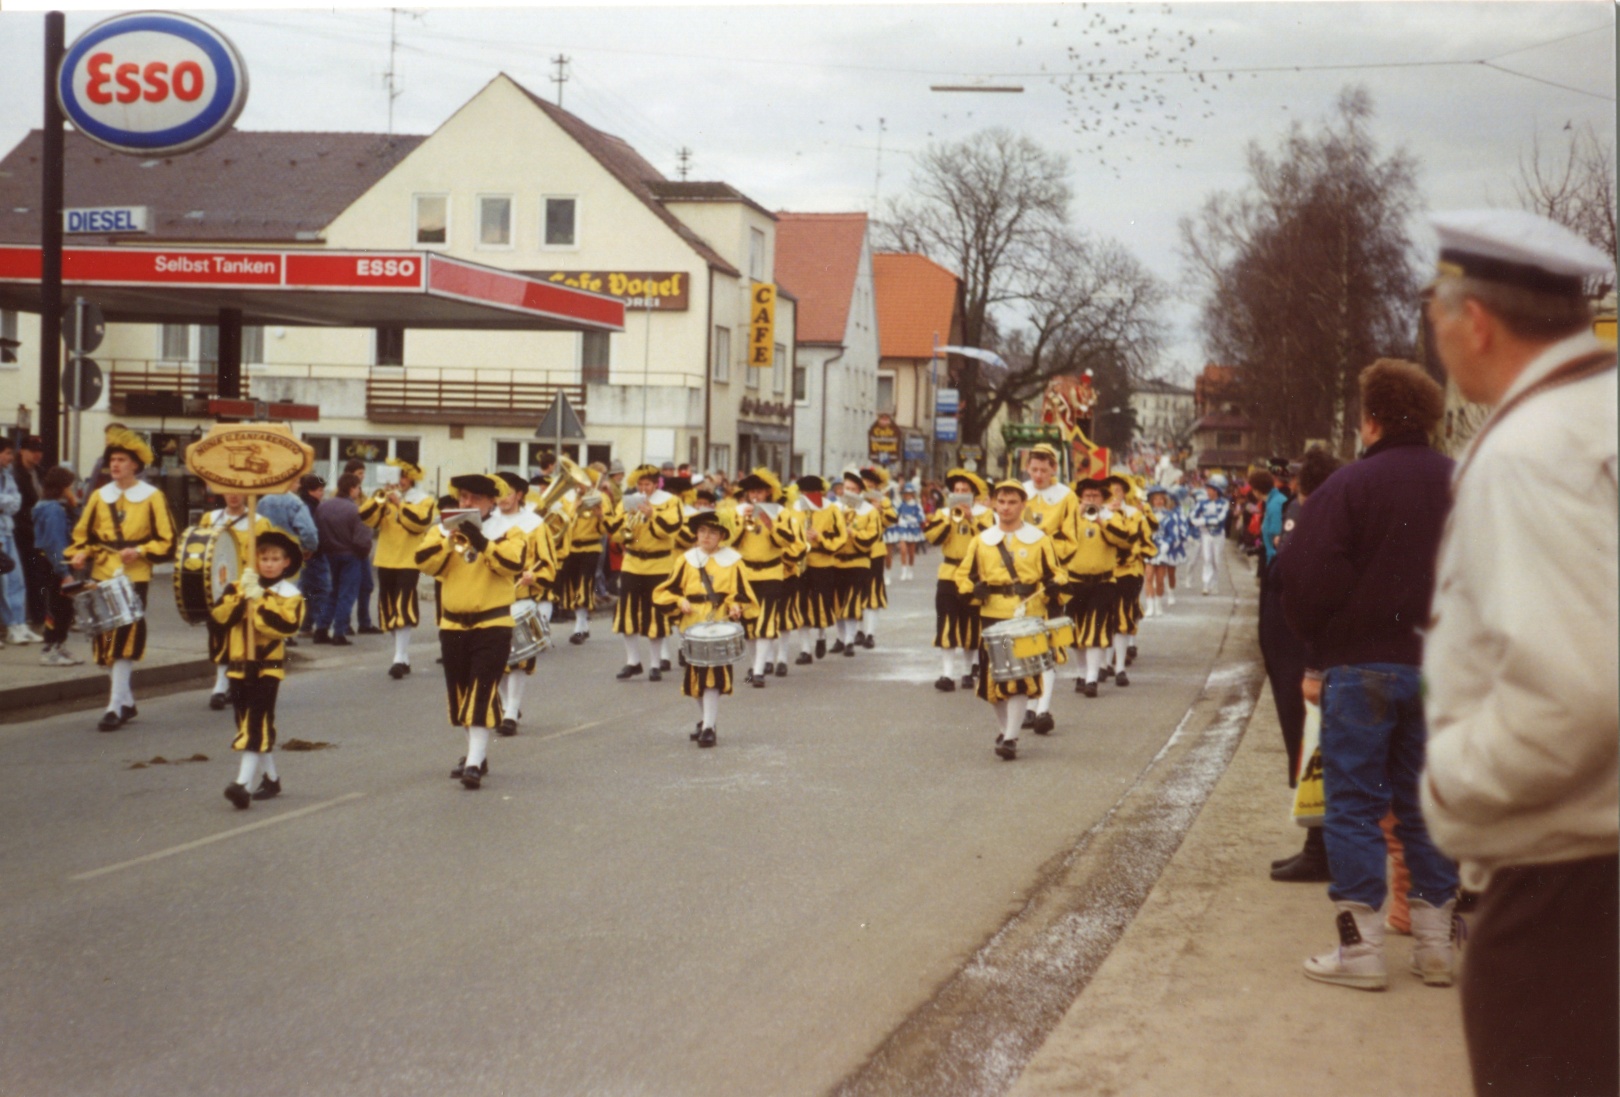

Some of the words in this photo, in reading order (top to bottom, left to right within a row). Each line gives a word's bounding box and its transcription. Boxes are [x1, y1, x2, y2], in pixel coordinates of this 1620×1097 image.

[68, 210, 137, 232] DIESEL
[155, 256, 209, 273] Selbst
[213, 257, 275, 274] Tanken
[357, 259, 415, 276] ESSO
[608, 272, 681, 297] Vogel
[754, 288, 771, 363] CAFE
